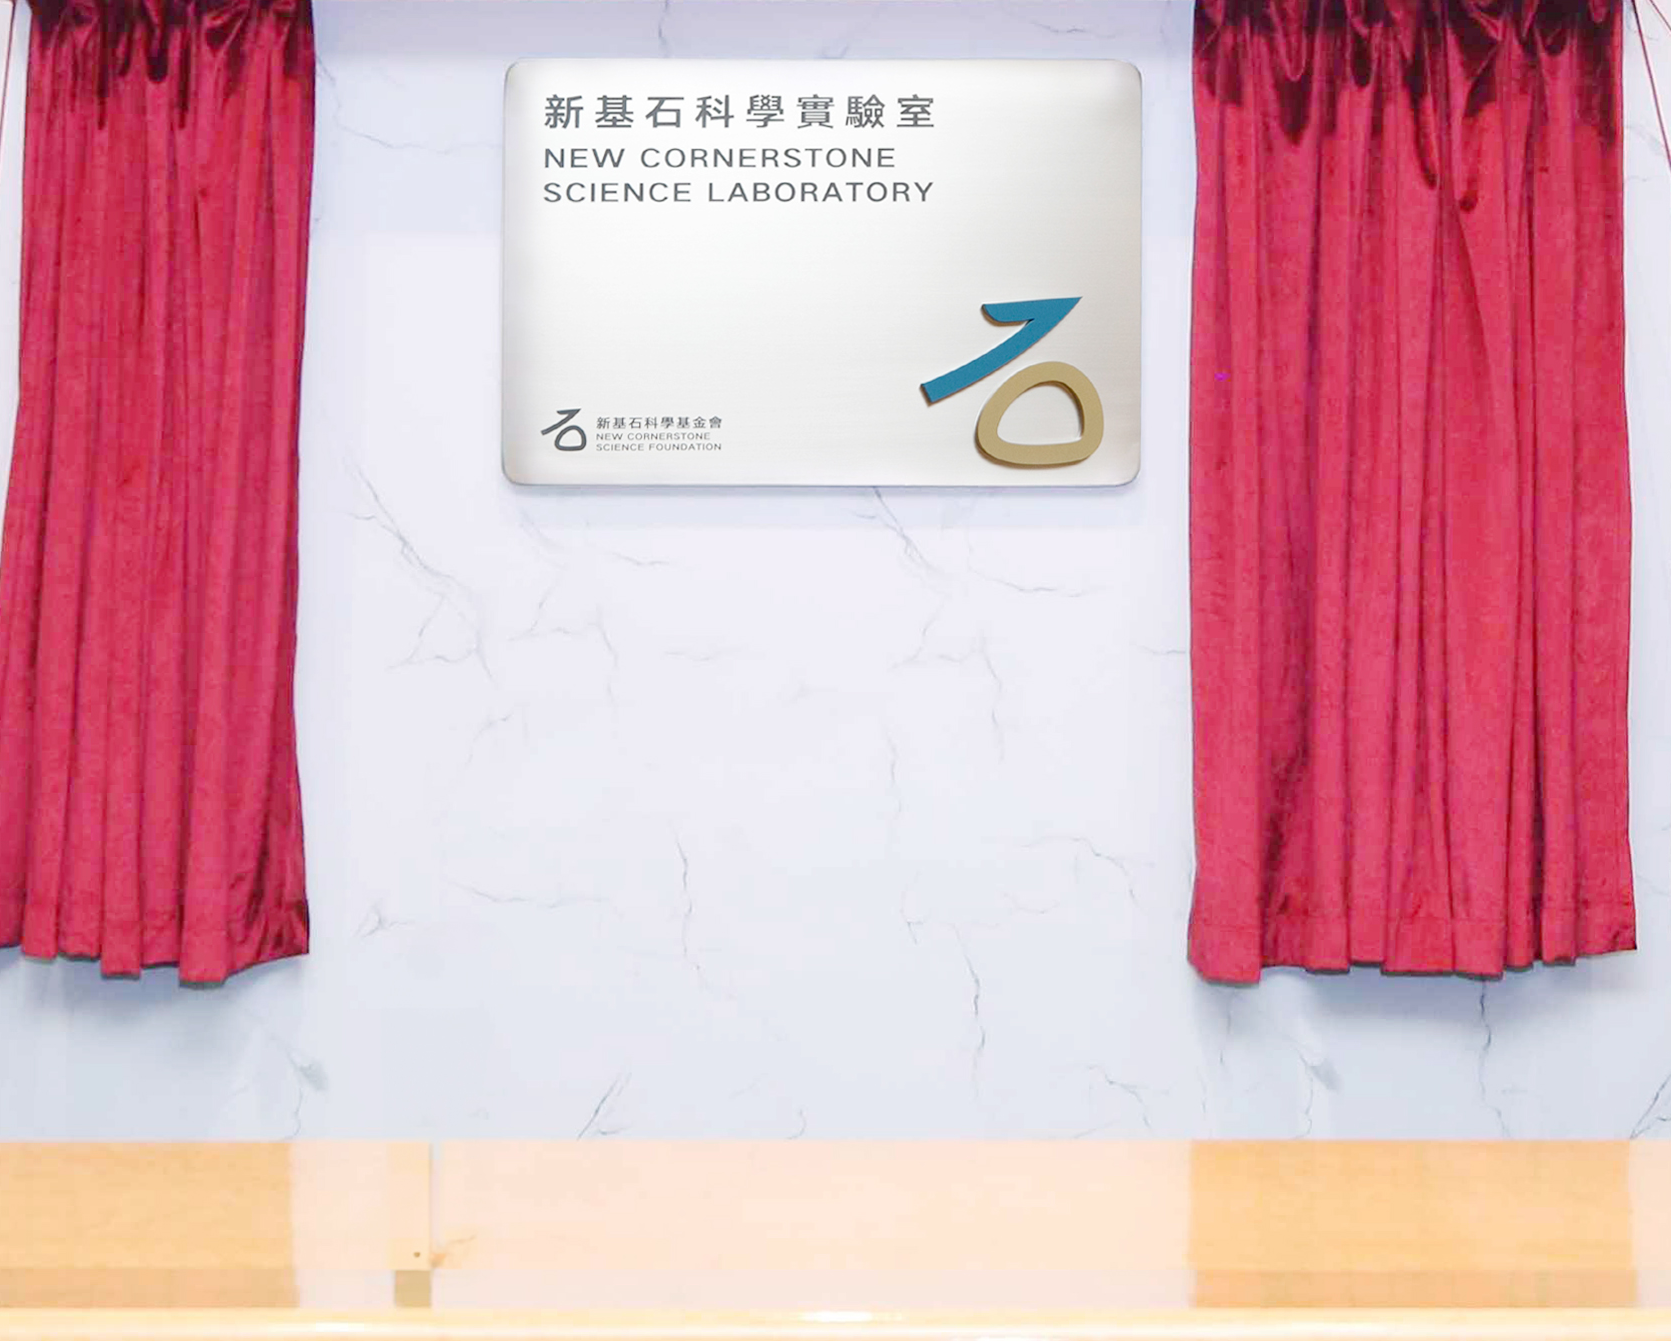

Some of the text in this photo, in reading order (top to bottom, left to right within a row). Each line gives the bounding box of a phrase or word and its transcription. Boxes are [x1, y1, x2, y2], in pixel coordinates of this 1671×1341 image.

[544, 94, 936, 129] 新基石科學實驗室
[545, 148, 894, 168] NEW CORNERSTONE
[544, 182, 932, 202] SCIENCE LABORATORY
[596, 416, 722, 430] 新基石科學基金會
[596, 432, 710, 441] NEW CORNERSTONE
[596, 443, 722, 452] SCIENCE FOUNDATION
